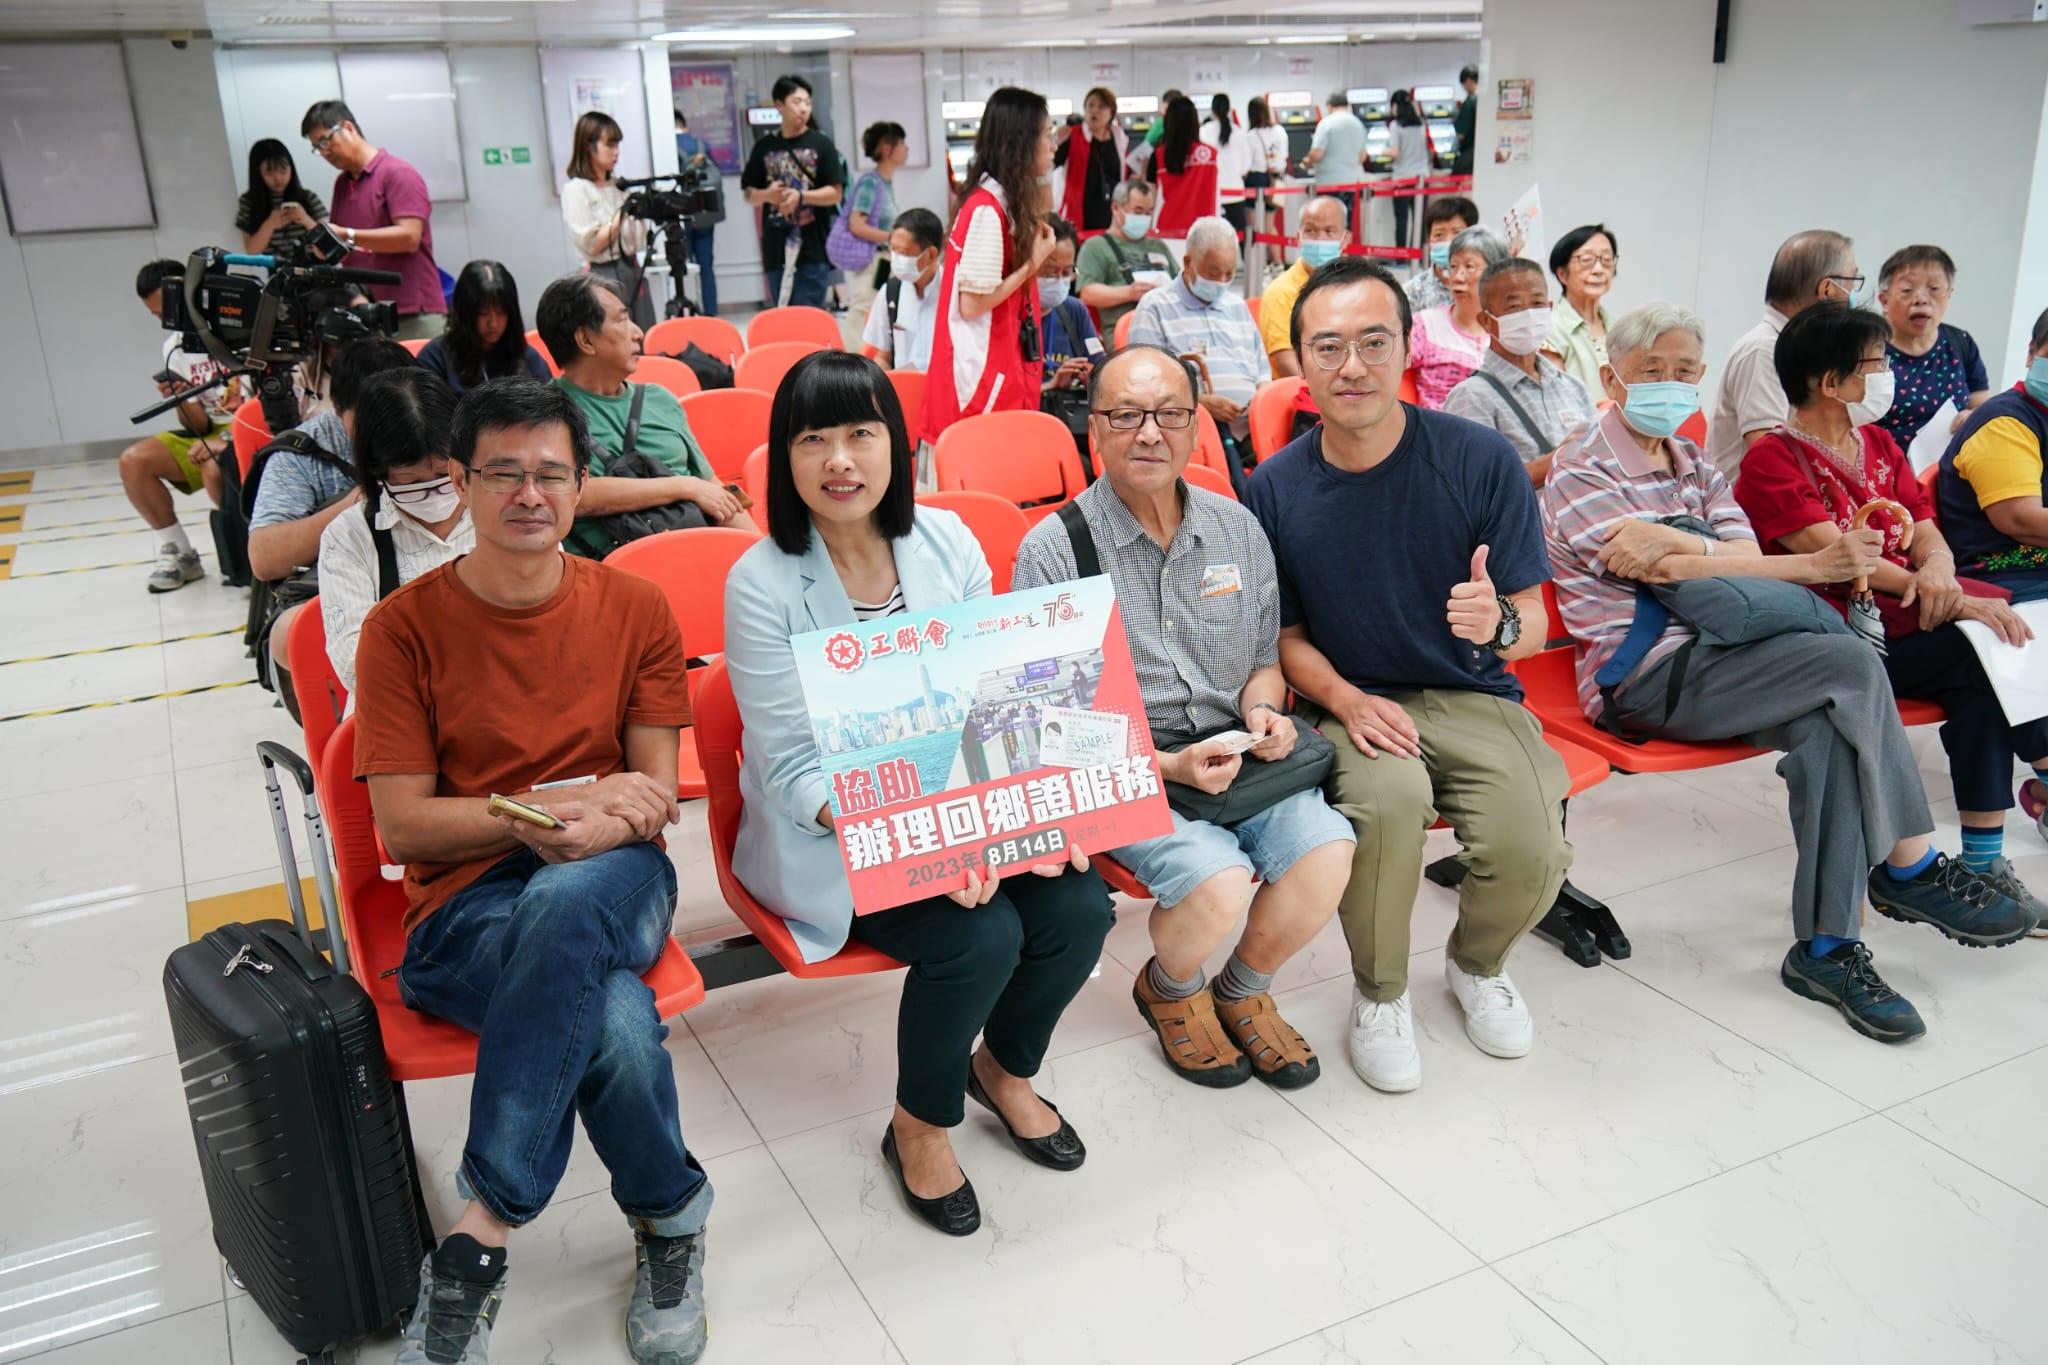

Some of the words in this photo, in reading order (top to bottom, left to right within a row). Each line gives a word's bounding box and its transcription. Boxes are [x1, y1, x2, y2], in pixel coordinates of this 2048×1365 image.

[870, 618, 950, 657] 工聯會
[1074, 732, 1113, 752] SAMPLE
[832, 757, 923, 817] 協助
[842, 754, 1160, 872] 辦理回鄉證服務
[906, 851, 982, 888] 2023年
[987, 829, 1064, 865] 8月14日
